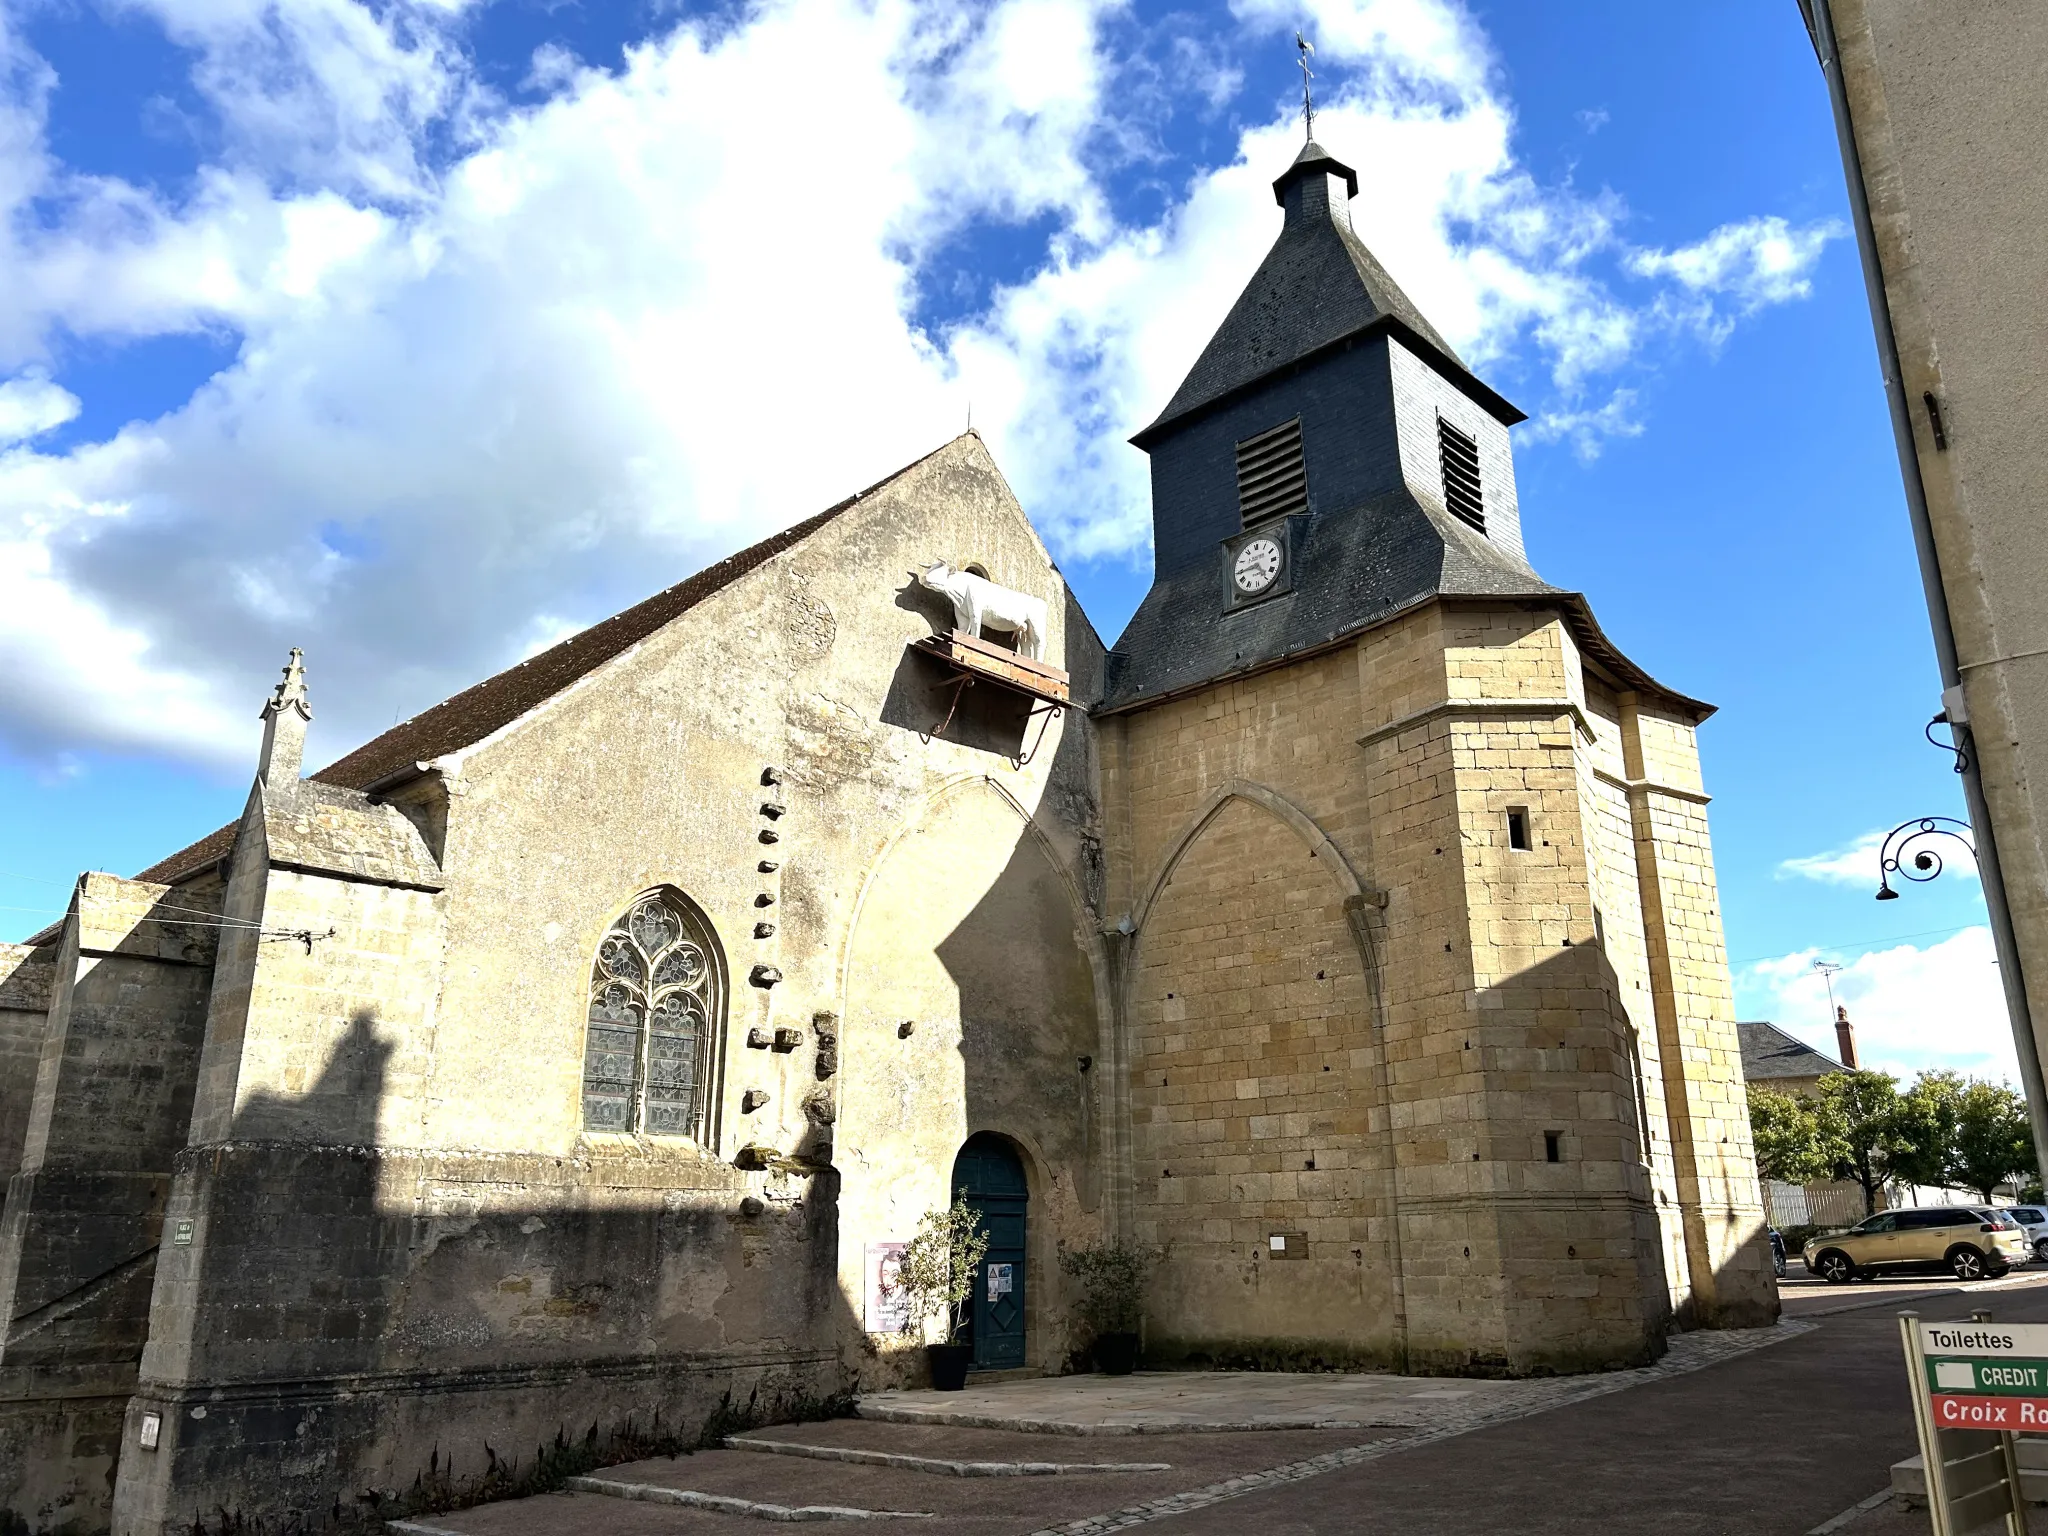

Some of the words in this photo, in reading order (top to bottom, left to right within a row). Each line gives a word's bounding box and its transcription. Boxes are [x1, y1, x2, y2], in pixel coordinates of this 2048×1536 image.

[1929, 1330, 2013, 1349] Toilettes
[1981, 1367, 2037, 1386] CREDIT
[1943, 1400, 2007, 1422] Croix
